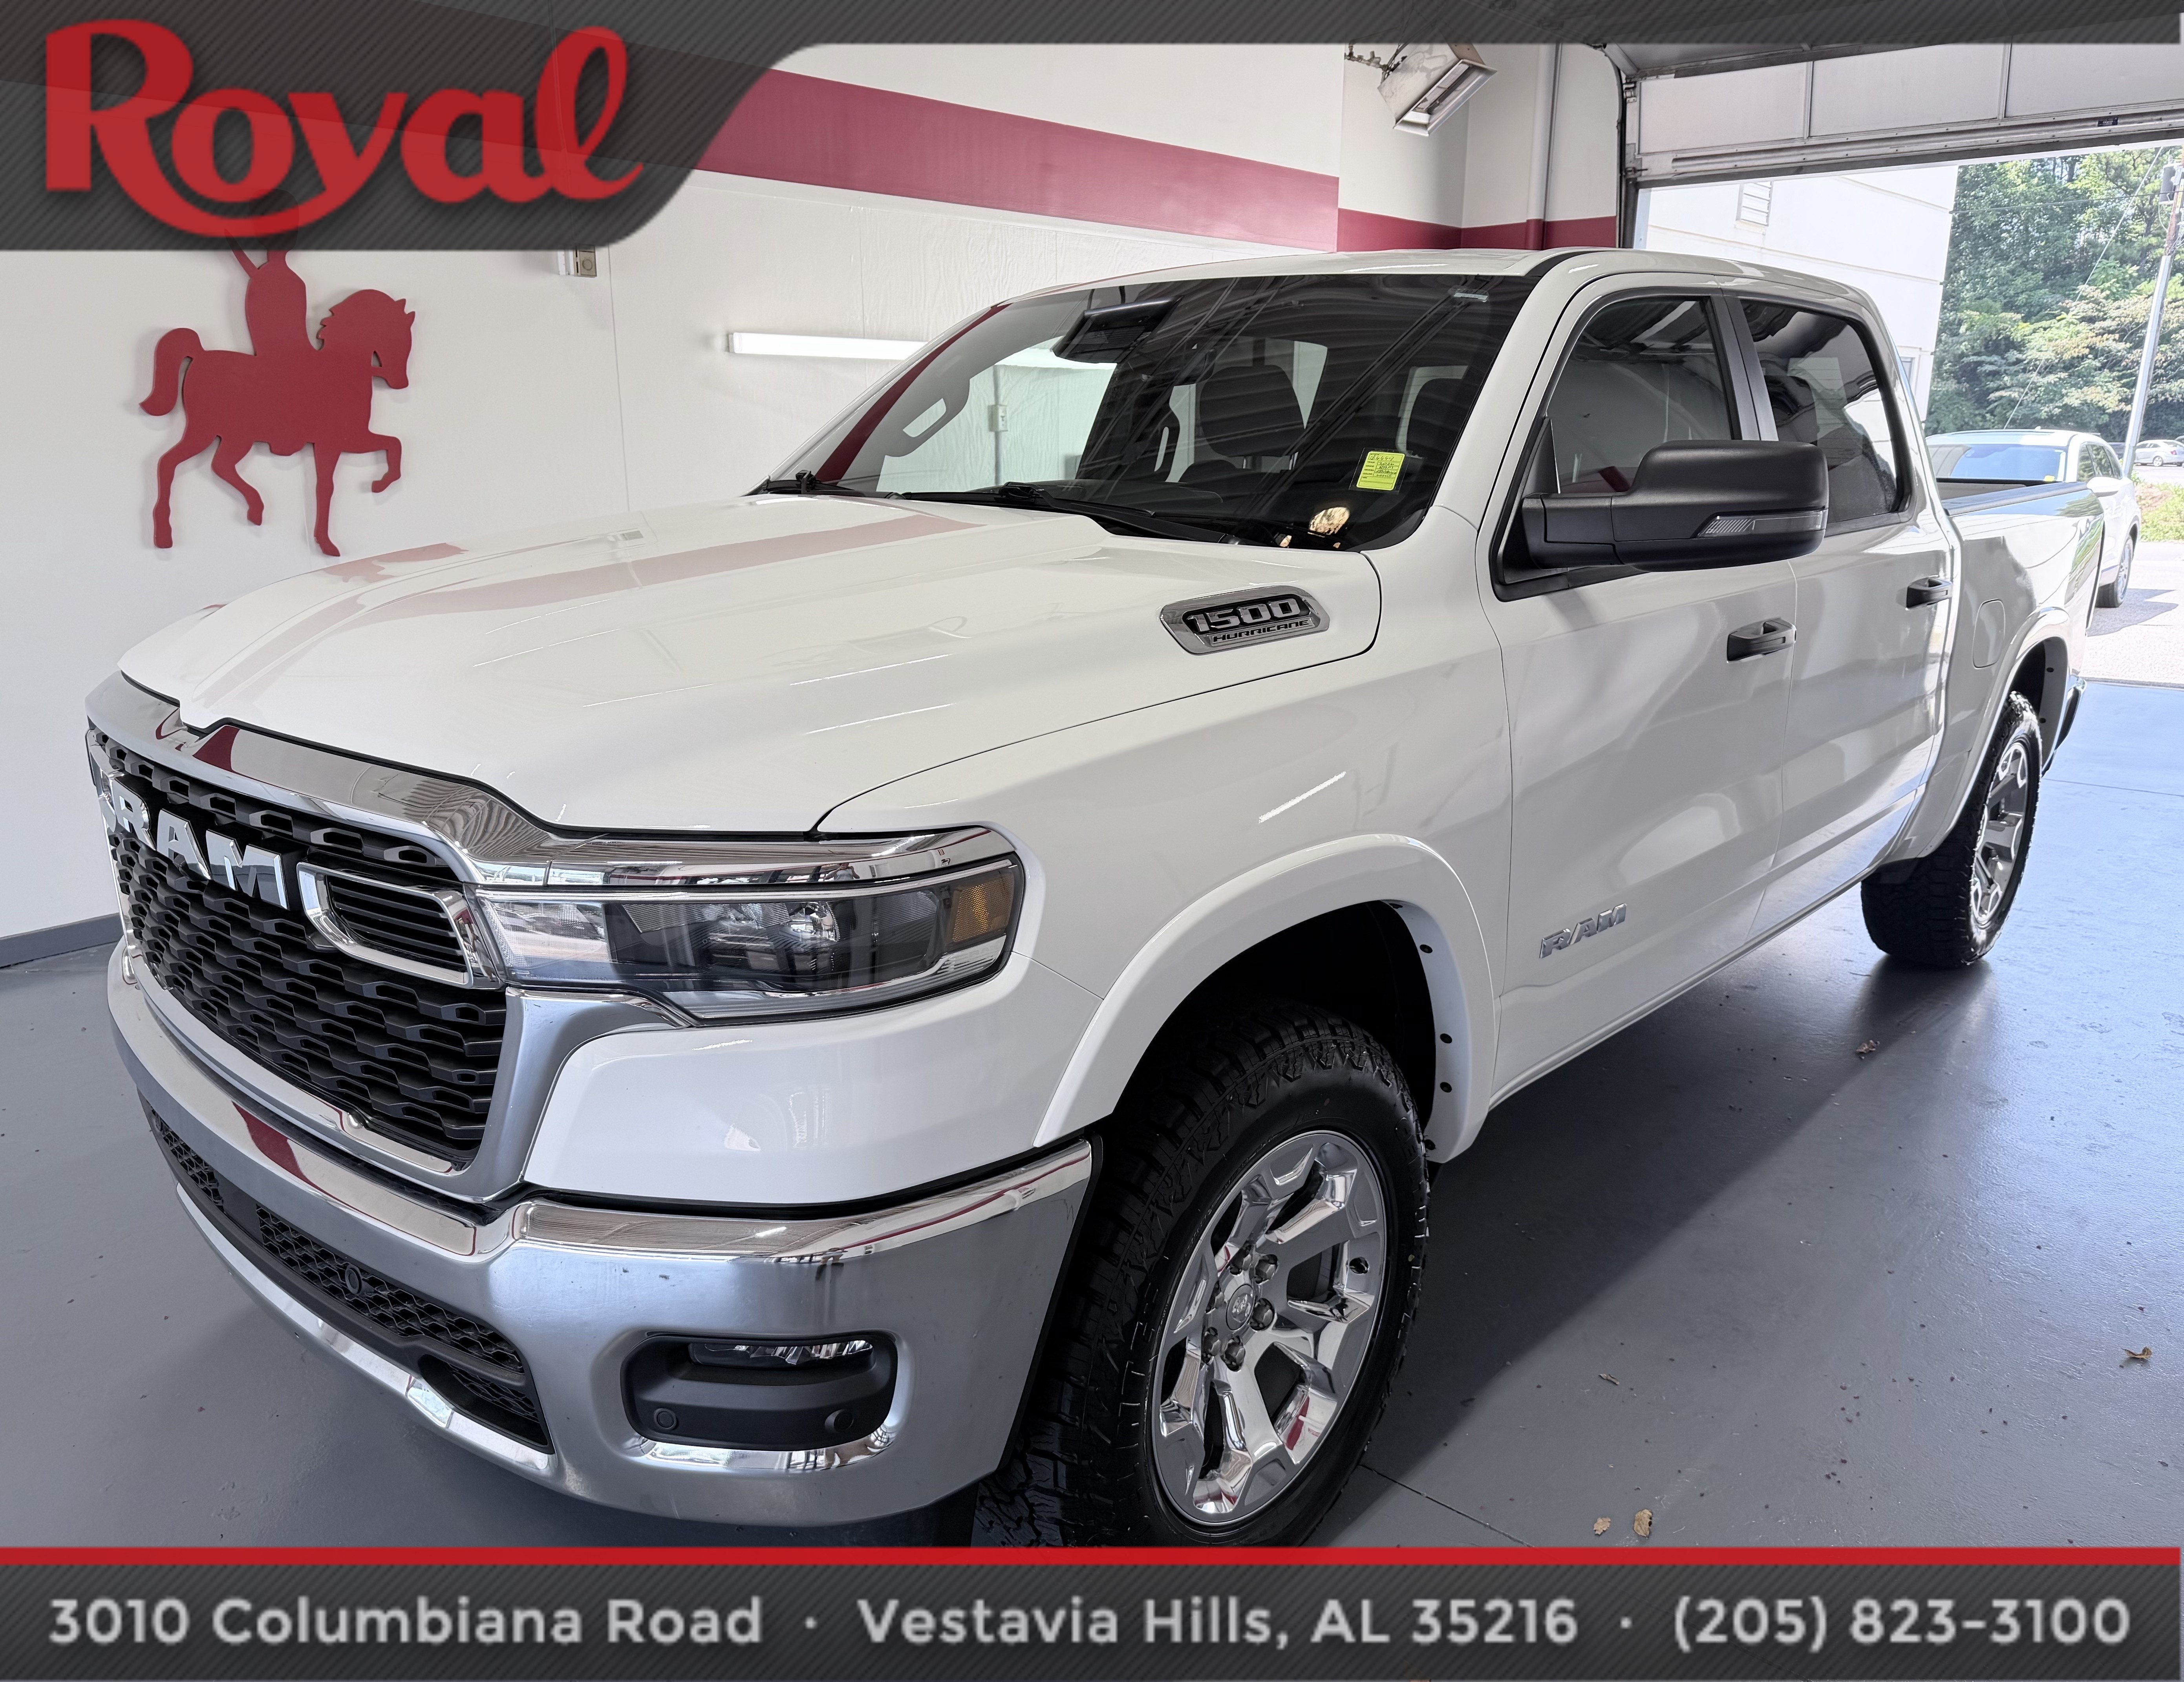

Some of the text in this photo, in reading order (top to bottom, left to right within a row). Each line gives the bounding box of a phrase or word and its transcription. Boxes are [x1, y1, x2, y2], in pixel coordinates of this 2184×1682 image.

[1187, 598, 1301, 632] 1500
[1213, 619, 1310, 642] HURRICANE
[112, 777, 291, 910] RAM
[1539, 903, 1627, 958] RAM
